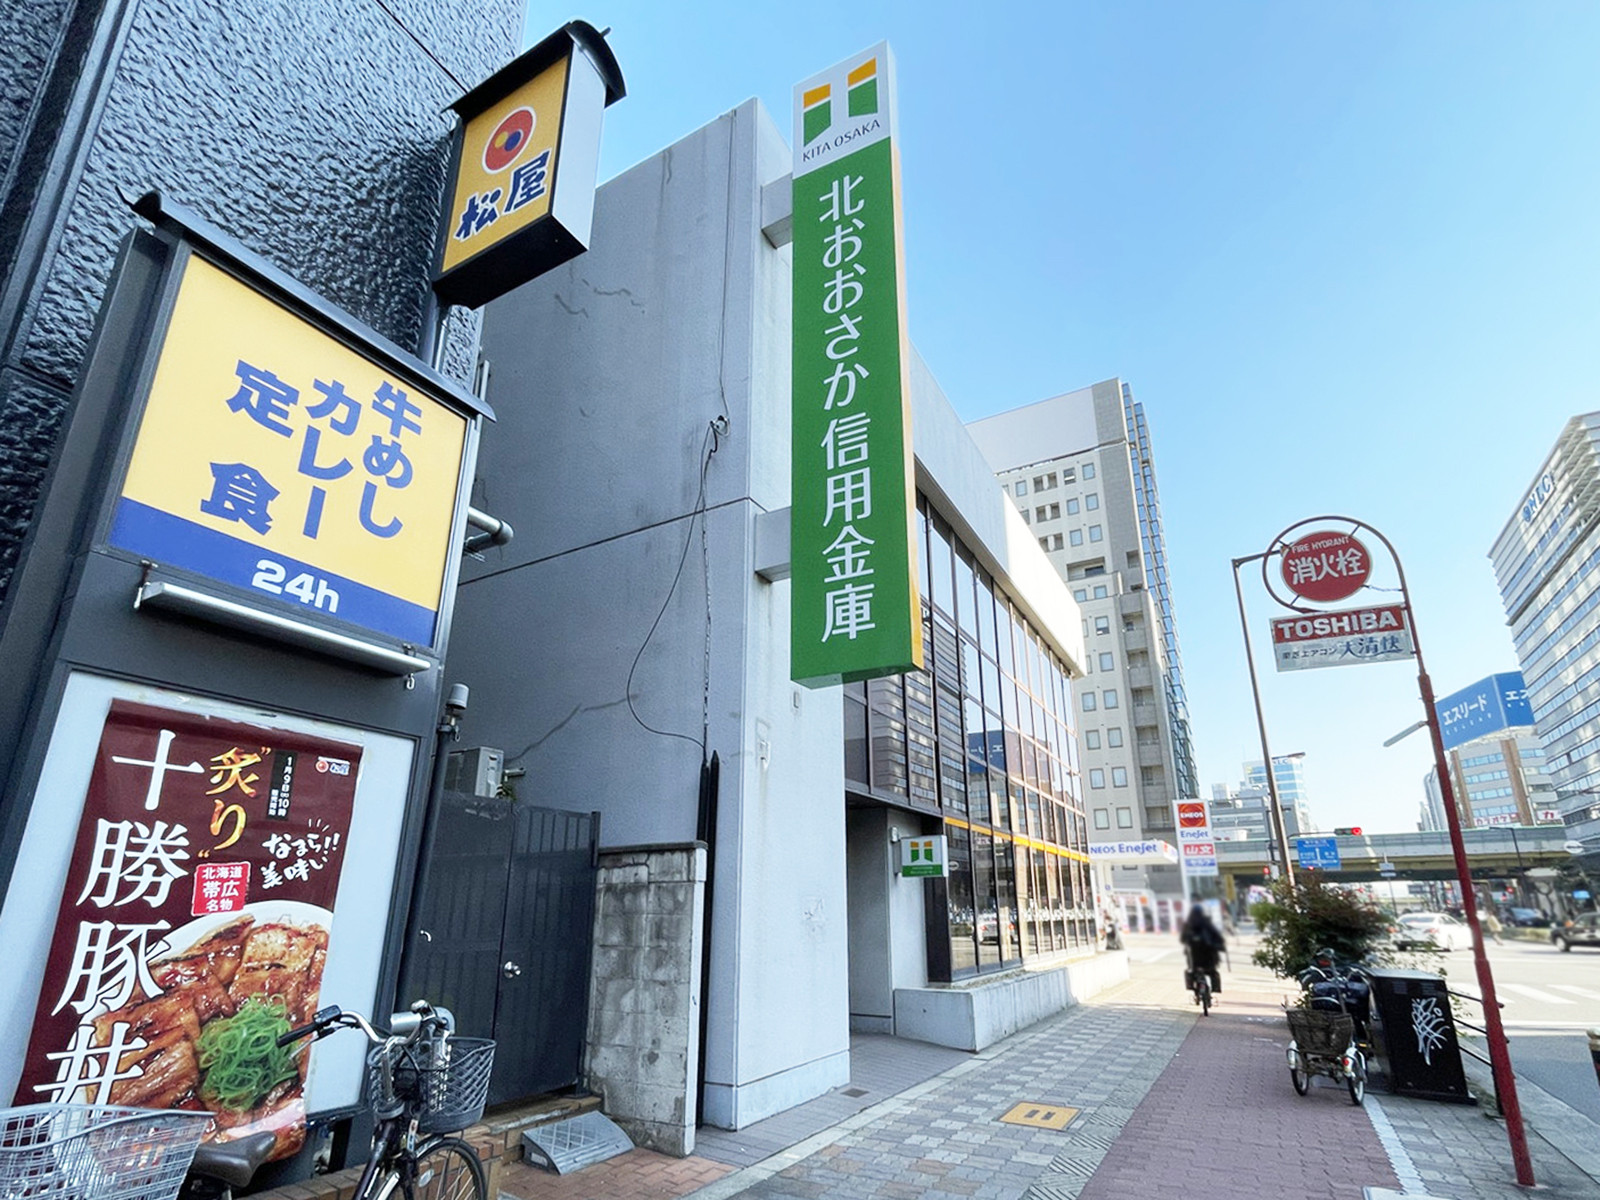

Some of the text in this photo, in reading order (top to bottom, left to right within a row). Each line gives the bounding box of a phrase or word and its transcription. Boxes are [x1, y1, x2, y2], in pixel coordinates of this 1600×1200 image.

[803, 119, 881, 162] KITA OSAKA
[454, 150, 552, 239] 松屋
[818, 174, 876, 643] 北おおさか信用金庫
[200, 359, 300, 536] 定食
[298, 378, 362, 540] カレー
[358, 380, 423, 539] 牛めし
[1292, 536, 1350, 553] FIRE HYDRANT
[1288, 547, 1366, 585] 消火栓
[252, 559, 340, 613] 24h
[1277, 611, 1399, 639] TOSHIBA
[1442, 692, 1488, 726] エスリード
[1180, 811, 1204, 819] ENEOS
[1090, 846, 1116, 854] NEOS
[202, 866, 243, 879] 北海道
[202, 880, 241, 899] 帯広
[34, 729, 204, 1106] 十勝豚丼
[206, 899, 233, 912] 名物
